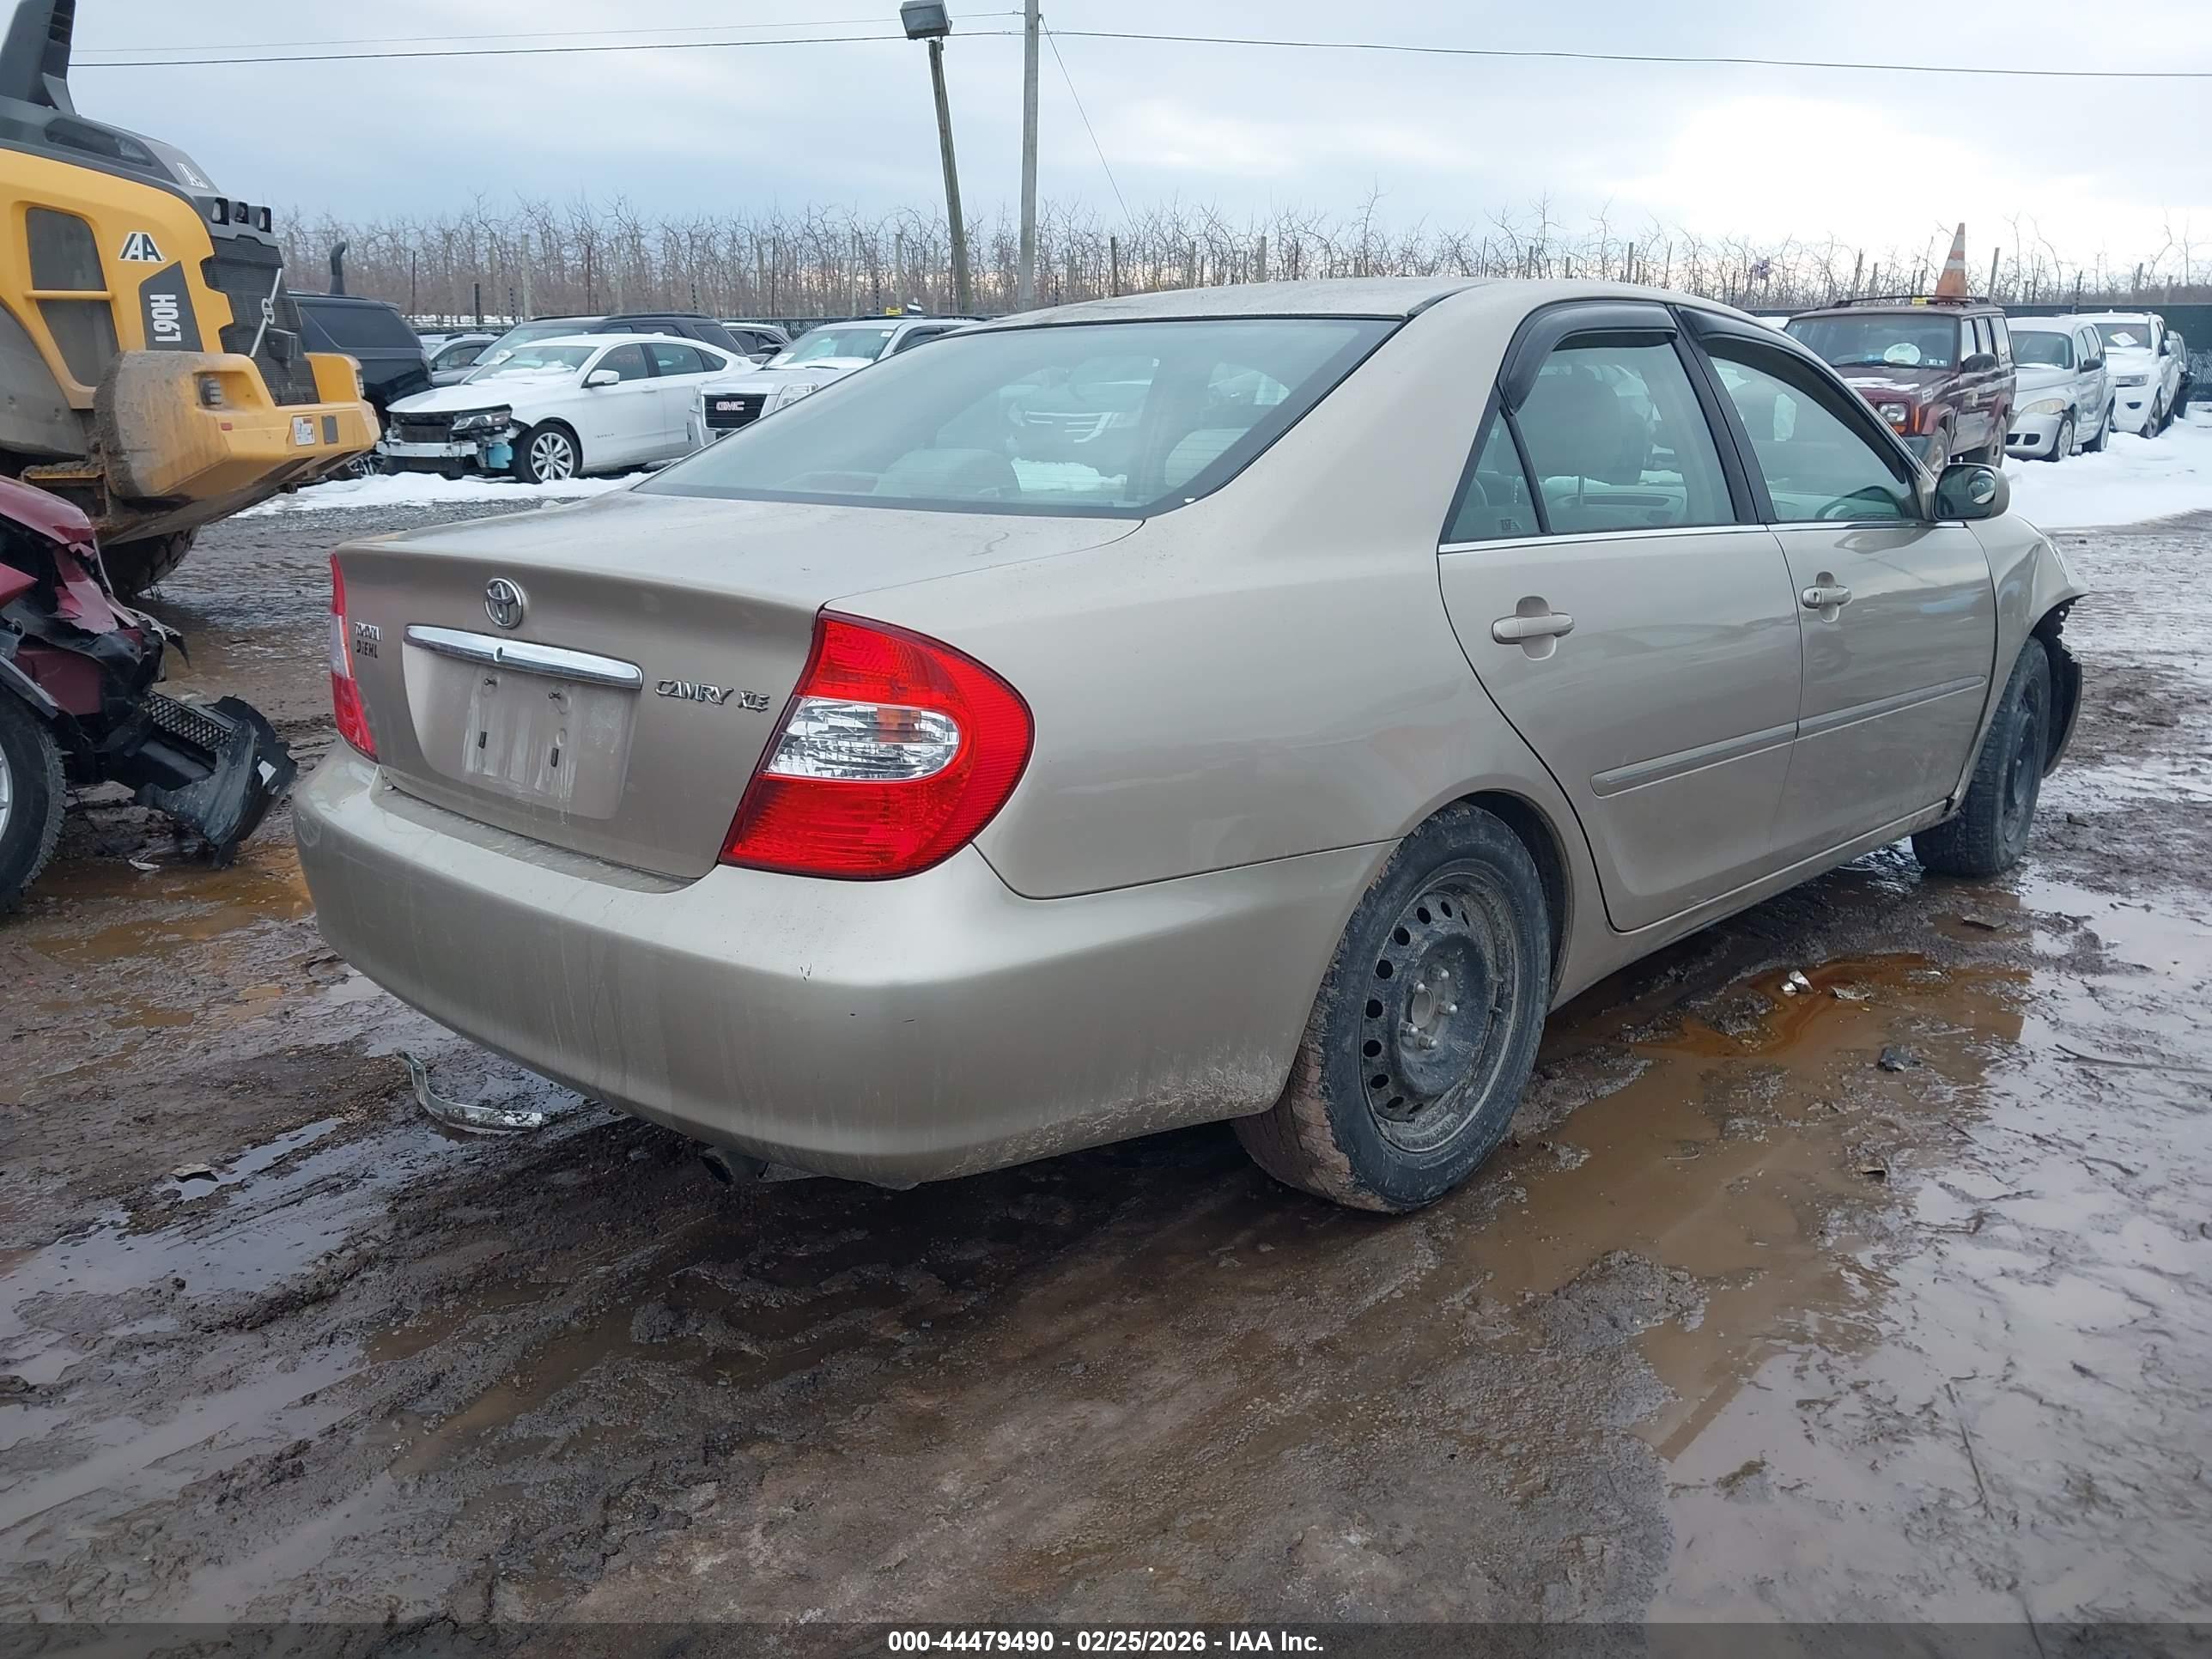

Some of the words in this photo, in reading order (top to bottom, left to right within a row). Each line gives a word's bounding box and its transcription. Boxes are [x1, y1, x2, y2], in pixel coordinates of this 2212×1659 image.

[149, 294, 182, 342] L90H
[715, 401, 745, 411] GMC
[654, 678, 734, 705] CAMRY
[738, 690, 770, 713] XLE
